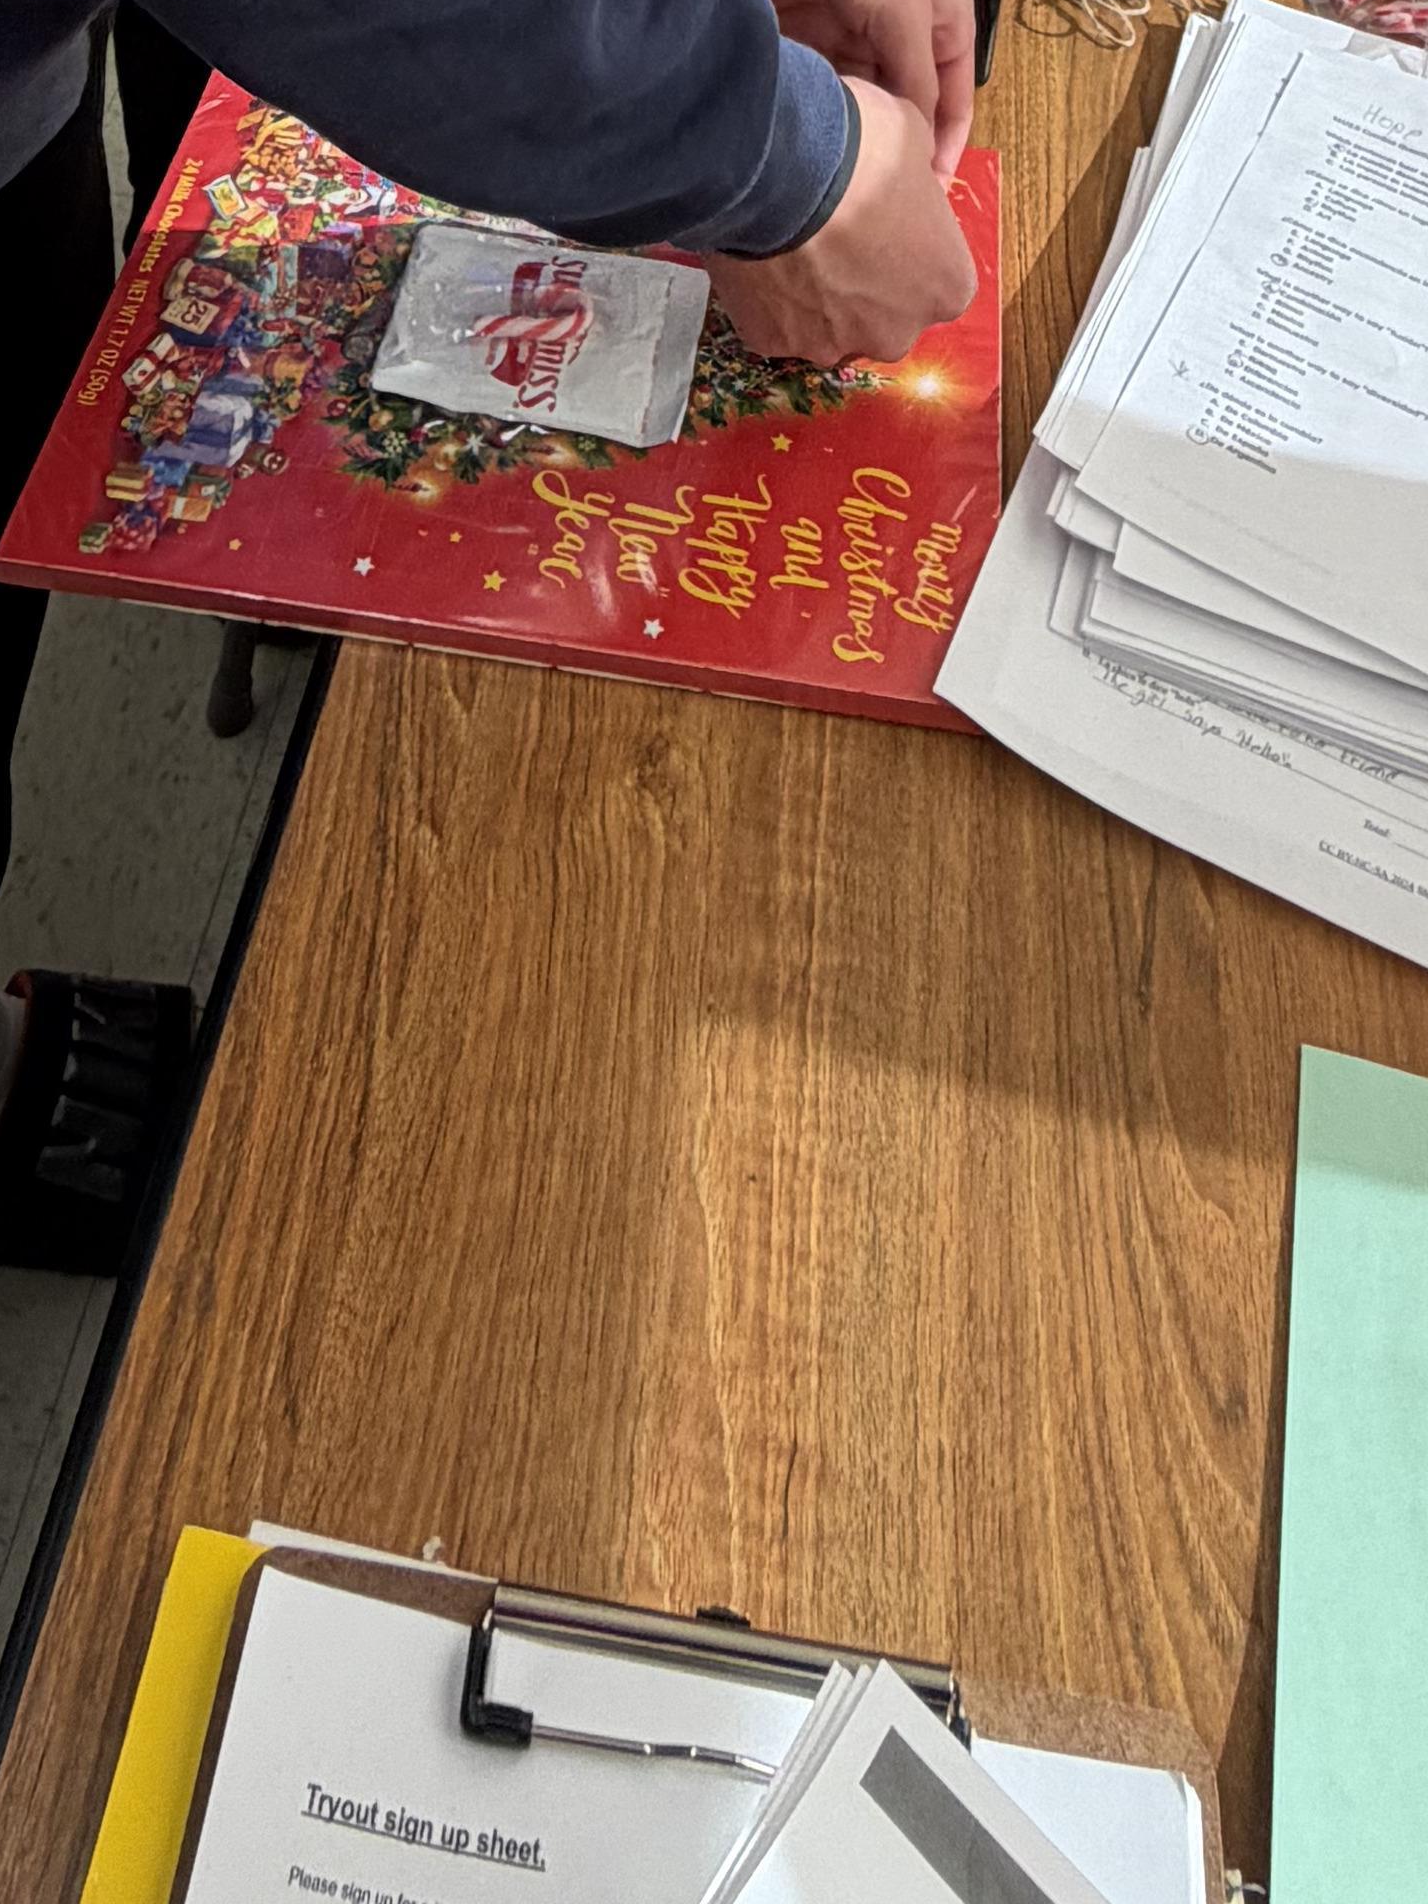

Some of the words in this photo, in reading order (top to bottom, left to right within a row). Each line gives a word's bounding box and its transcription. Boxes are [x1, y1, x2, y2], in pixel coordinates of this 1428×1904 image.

[1361, 104, 1423, 142] Hope
[185, 158, 203, 173] 24
[1323, 194, 1358, 214] Culture
[1327, 186, 1374, 213] Language
[1349, 186, 1370, 200] dice
[1397, 208, 1410, 217] en
[1315, 209, 1332, 221] Art
[139, 203, 183, 273] Chocolates
[1303, 235, 1351, 262] Language
[1326, 235, 1348, 249] dice
[1291, 261, 1333, 286] Ancestry
[128, 279, 150, 299] NET
[122, 303, 140, 327] WT
[181, 299, 208, 324] 25
[1282, 279, 1292, 288] is
[1292, 284, 1330, 307] another
[1331, 302, 1352, 317] way
[1353, 312, 1365, 321] to
[1365, 318, 1384, 332] say
[103, 349, 120, 370] OZ
[1266, 340, 1305, 364] another
[1306, 360, 1327, 375] way
[1328, 371, 1340, 380] to
[1341, 377, 1360, 391] say
[76, 369, 112, 406] (50g)
[1219, 414, 1234, 426] De
[1224, 404, 1239, 416] De
[1214, 425, 1230, 437] De
[1209, 436, 1224, 448] De
[1224, 444, 1276, 475] Argentina
[532, 470, 615, 588] Year
[609, 485, 696, 584] New
[679, 474, 771, 619] Happy
[770, 518, 829, 589] and
[832, 467, 911, 664] Christmas
[1317, 839, 1336, 856] CC
[306, 1782, 379, 1823] Tryout
[384, 1806, 433, 1844] sign
[440, 1824, 470, 1854] up
[477, 1829, 546, 1872] sheet.
[288, 1865, 337, 1896] Please
[341, 1881, 371, 1904] sign
